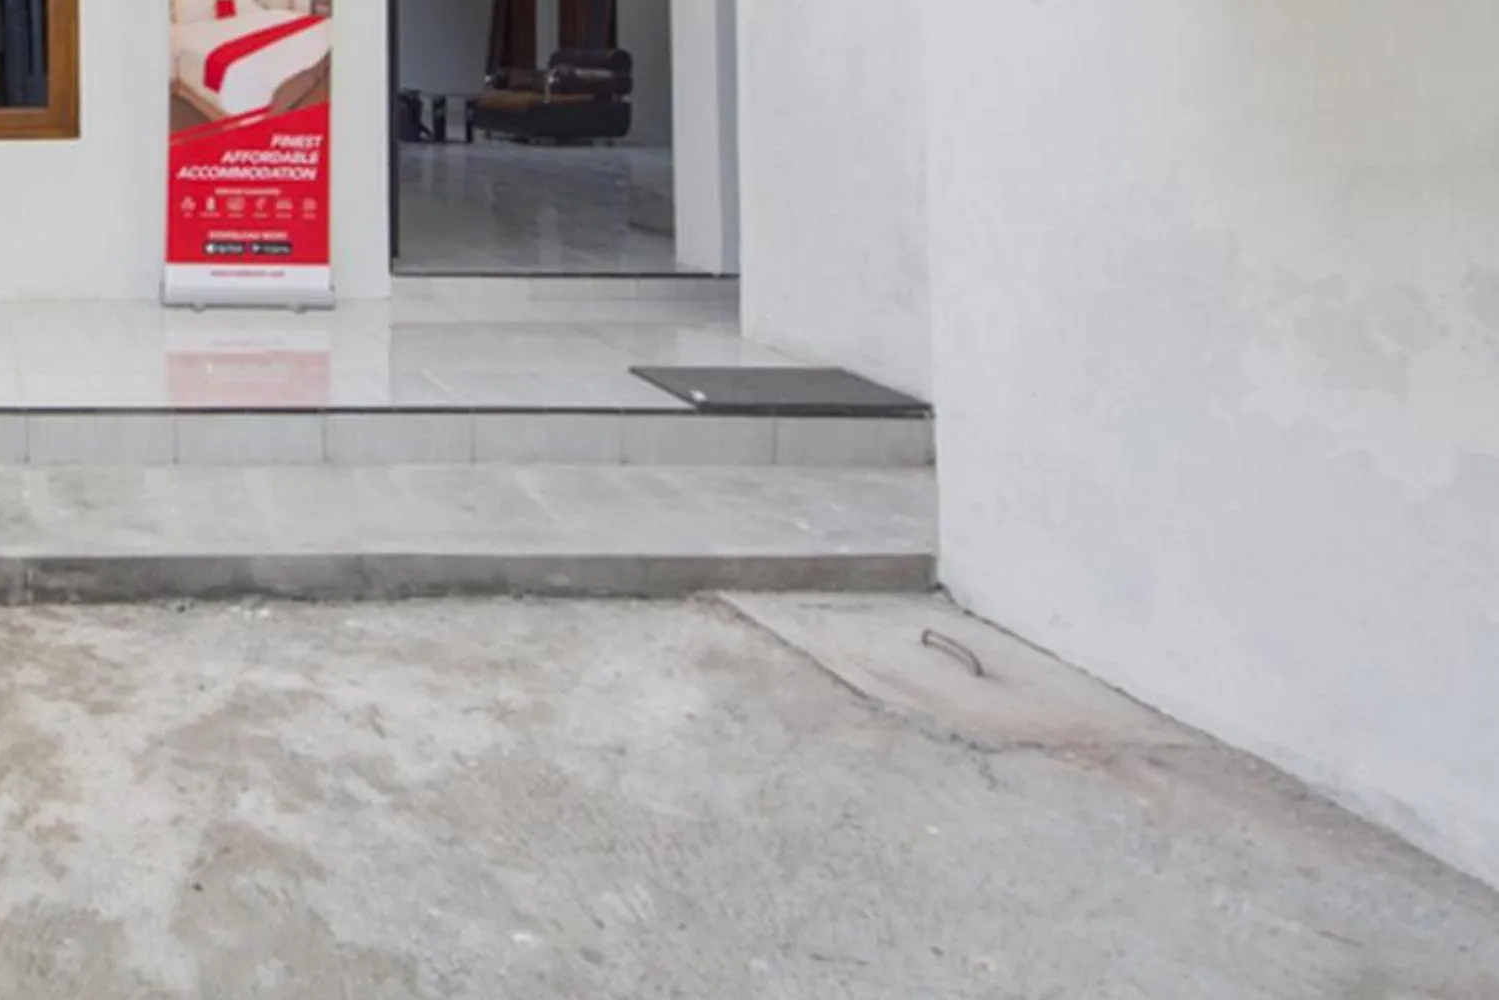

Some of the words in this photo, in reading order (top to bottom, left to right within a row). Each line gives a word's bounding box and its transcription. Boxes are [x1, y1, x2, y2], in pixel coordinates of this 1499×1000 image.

[271, 134, 323, 147] FINEST
[221, 150, 319, 164] AFFORDABLE
[177, 166, 317, 180] ACCOMMODATION
